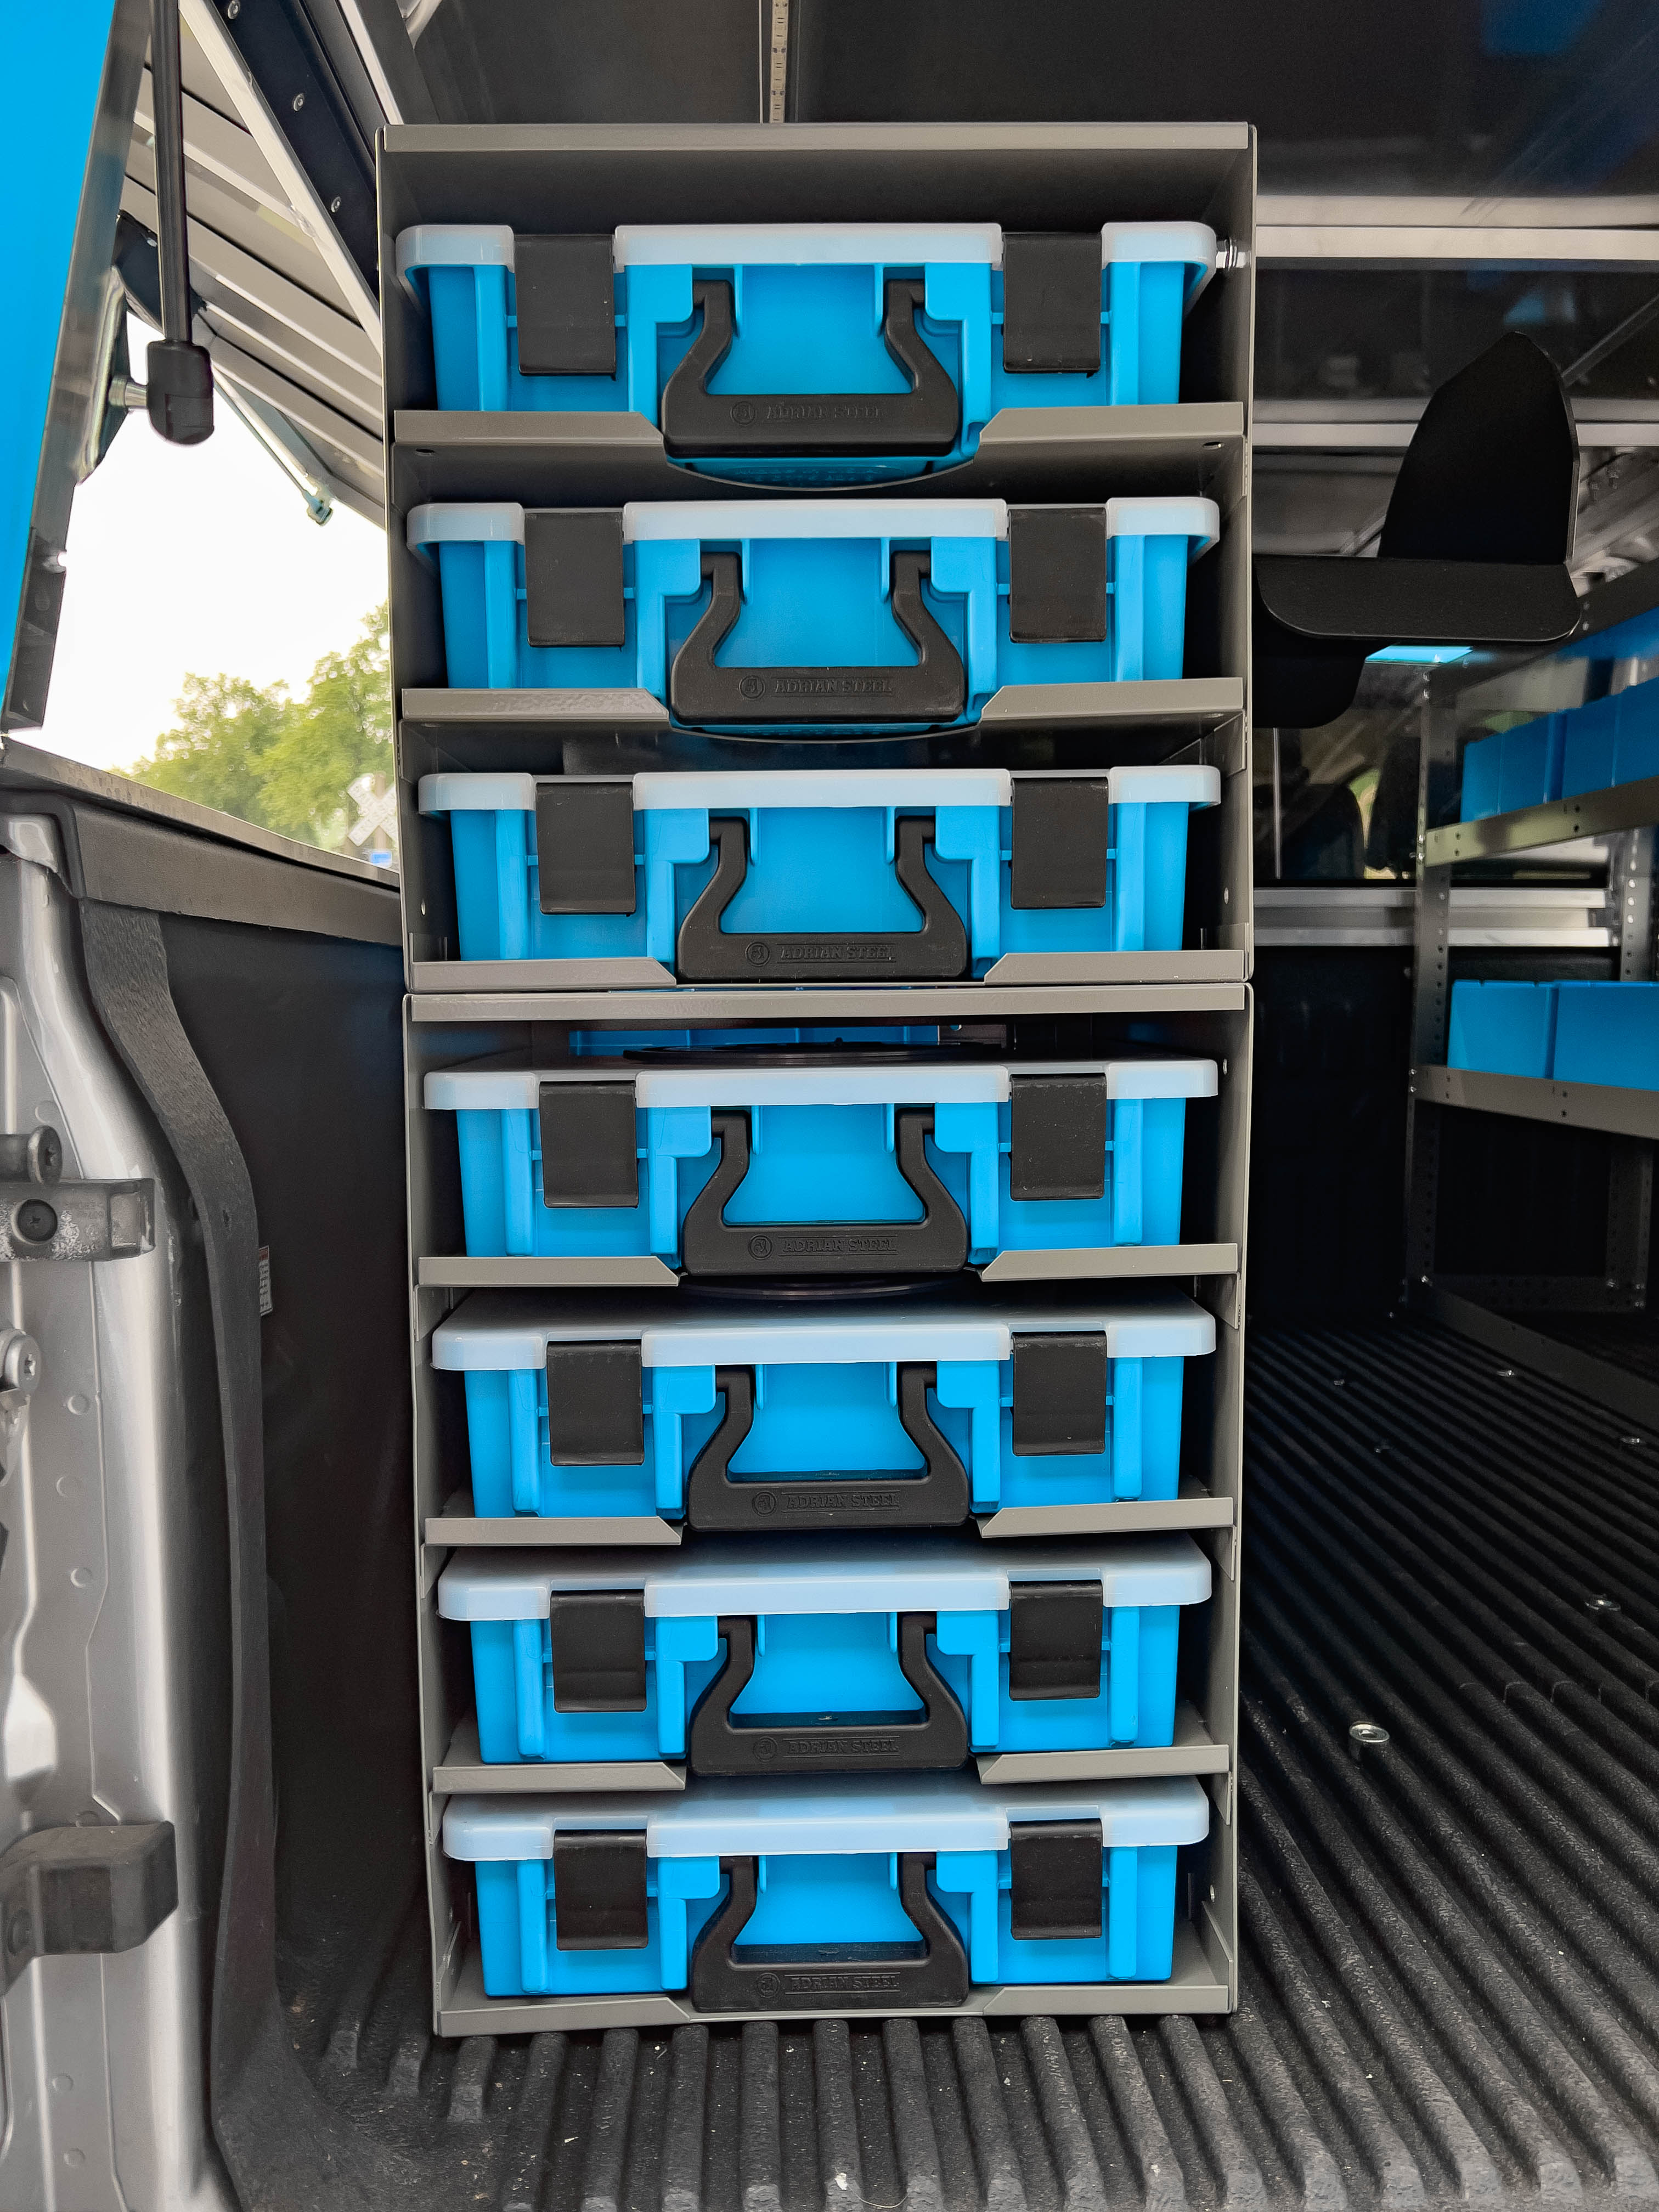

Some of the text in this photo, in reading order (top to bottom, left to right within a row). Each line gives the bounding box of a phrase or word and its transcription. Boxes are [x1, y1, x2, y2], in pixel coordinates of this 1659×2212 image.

[775, 680, 837, 693] ADRIAN
[781, 945, 896, 960] ADRIAN STEEL
[783, 1238, 896, 1252] ADRIAN STEEL
[786, 1493, 899, 1509] ADRIAN STEEL
